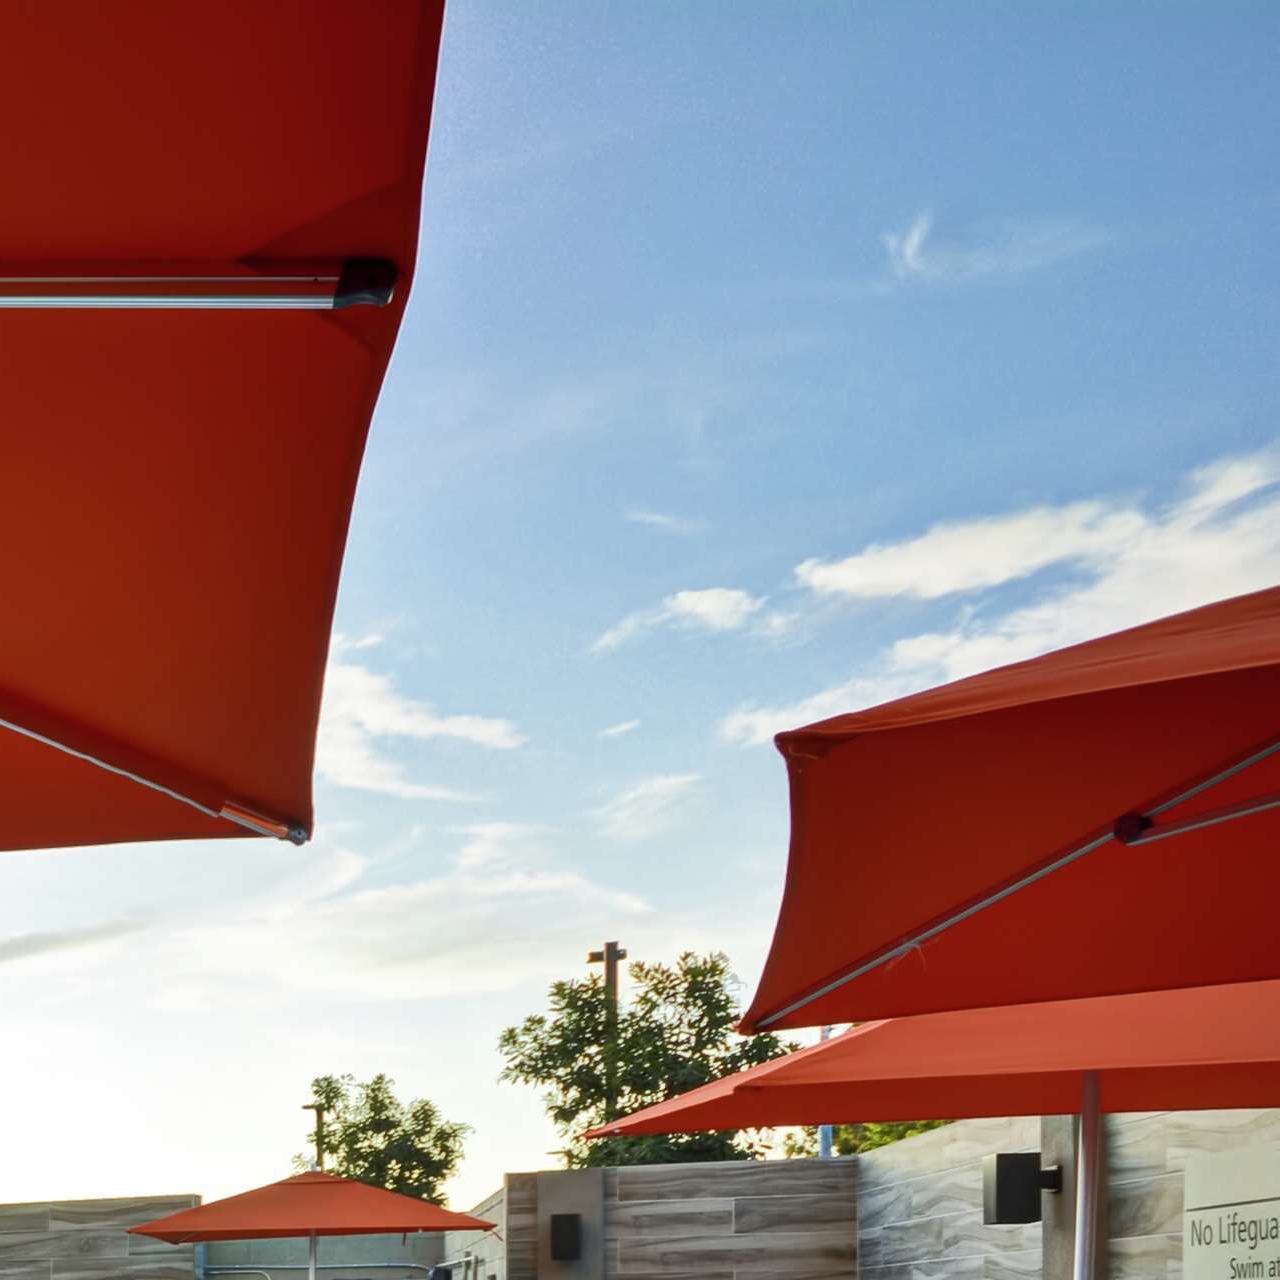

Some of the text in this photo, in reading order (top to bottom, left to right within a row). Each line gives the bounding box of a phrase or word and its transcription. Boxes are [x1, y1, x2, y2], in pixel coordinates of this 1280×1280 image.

[1191, 1212, 1279, 1250] No Lifegua
[1230, 1256, 1264, 1280] Swim
